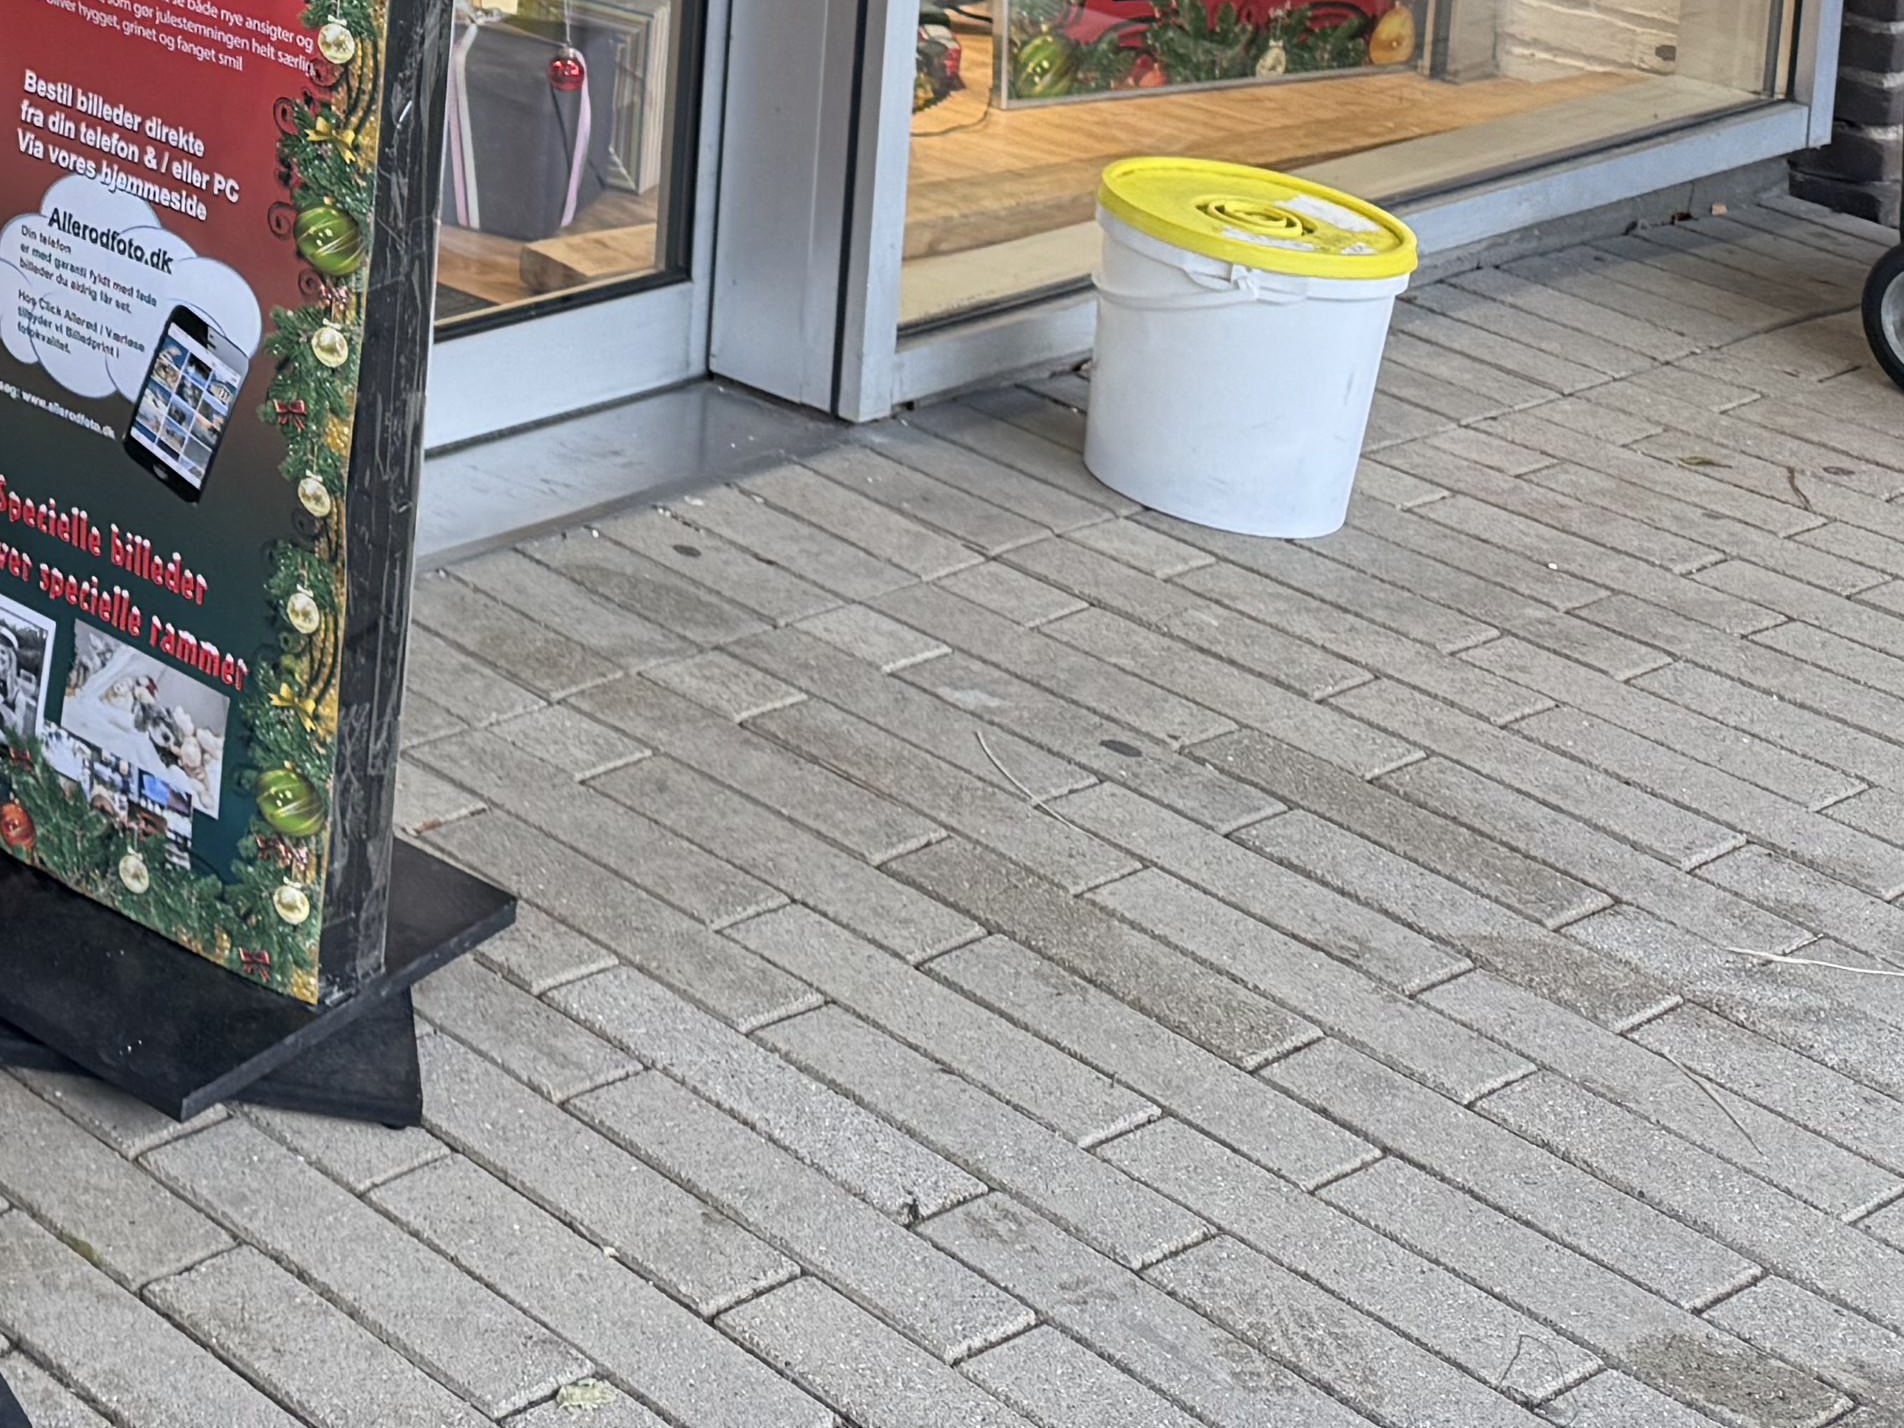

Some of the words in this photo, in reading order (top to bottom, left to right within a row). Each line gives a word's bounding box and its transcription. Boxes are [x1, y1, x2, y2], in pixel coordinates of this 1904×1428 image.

[122, 17, 157, 45] grinet
[158, 32, 176, 51] og
[177, 34, 216, 63] fanget
[218, 50, 244, 72] smil
[133, 0, 154, 19] gør
[155, 3, 250, 51] julestemningen
[252, 38, 276, 60] helt
[221, 6, 244, 27] nye
[245, 11, 295, 42] ansigter
[296, 32, 314, 54] og
[20, 99, 44, 128] fra
[48, 110, 76, 140] din
[79, 122, 140, 164] telefon
[143, 145, 158, 171] &
[172, 158, 210, 191] eller
[212, 172, 240, 204] PC
[23, 68, 73, 108] Bestil
[76, 87, 142, 133] billeder
[144, 114, 205, 159] direkte
[17, 127, 45, 160] Via
[48, 143, 97, 180] vores
[100, 159, 208, 222] hjemmeside
[48, 207, 174, 276] Allerodfoto.dk
[110, 523, 208, 607] billeder
[39, 563, 142, 638] specielle
[150, 614, 249, 692] rammer
